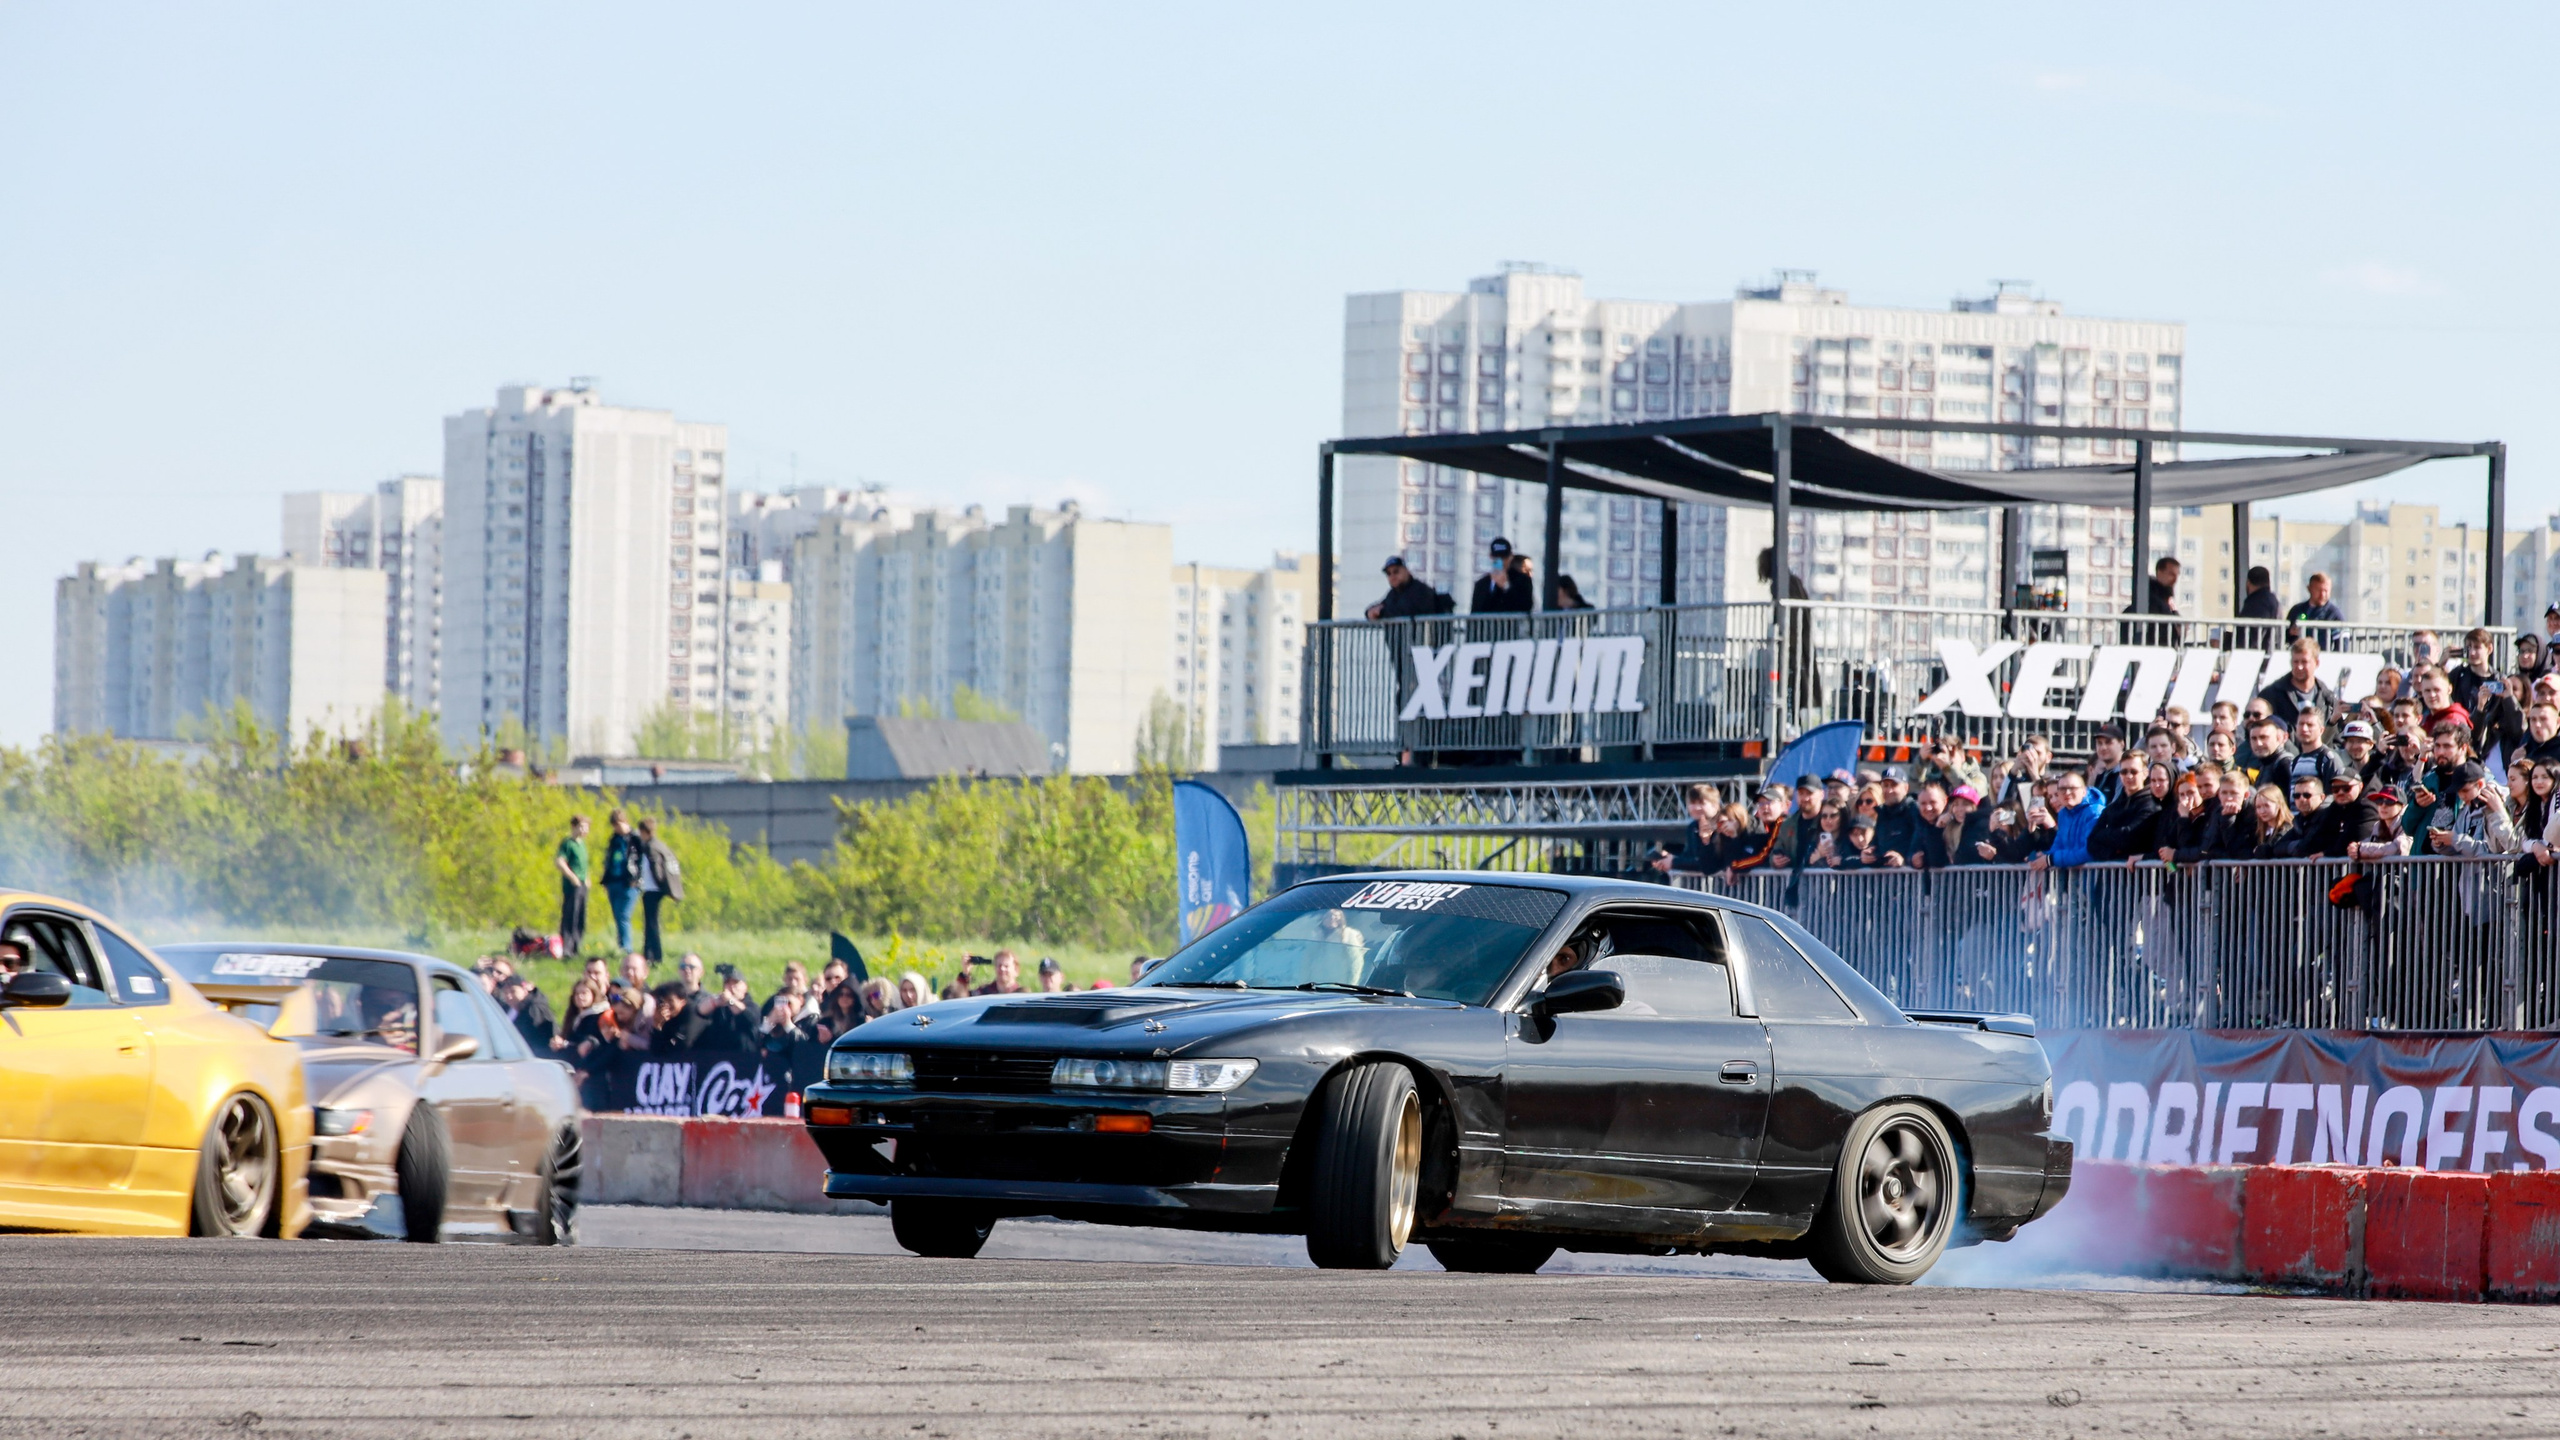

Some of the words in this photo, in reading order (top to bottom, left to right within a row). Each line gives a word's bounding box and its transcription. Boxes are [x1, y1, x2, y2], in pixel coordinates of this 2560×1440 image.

[1399, 635, 1645, 721] XENUM
[1402, 882, 1472, 899] DRIFT
[1395, 896, 1446, 911] FEST
